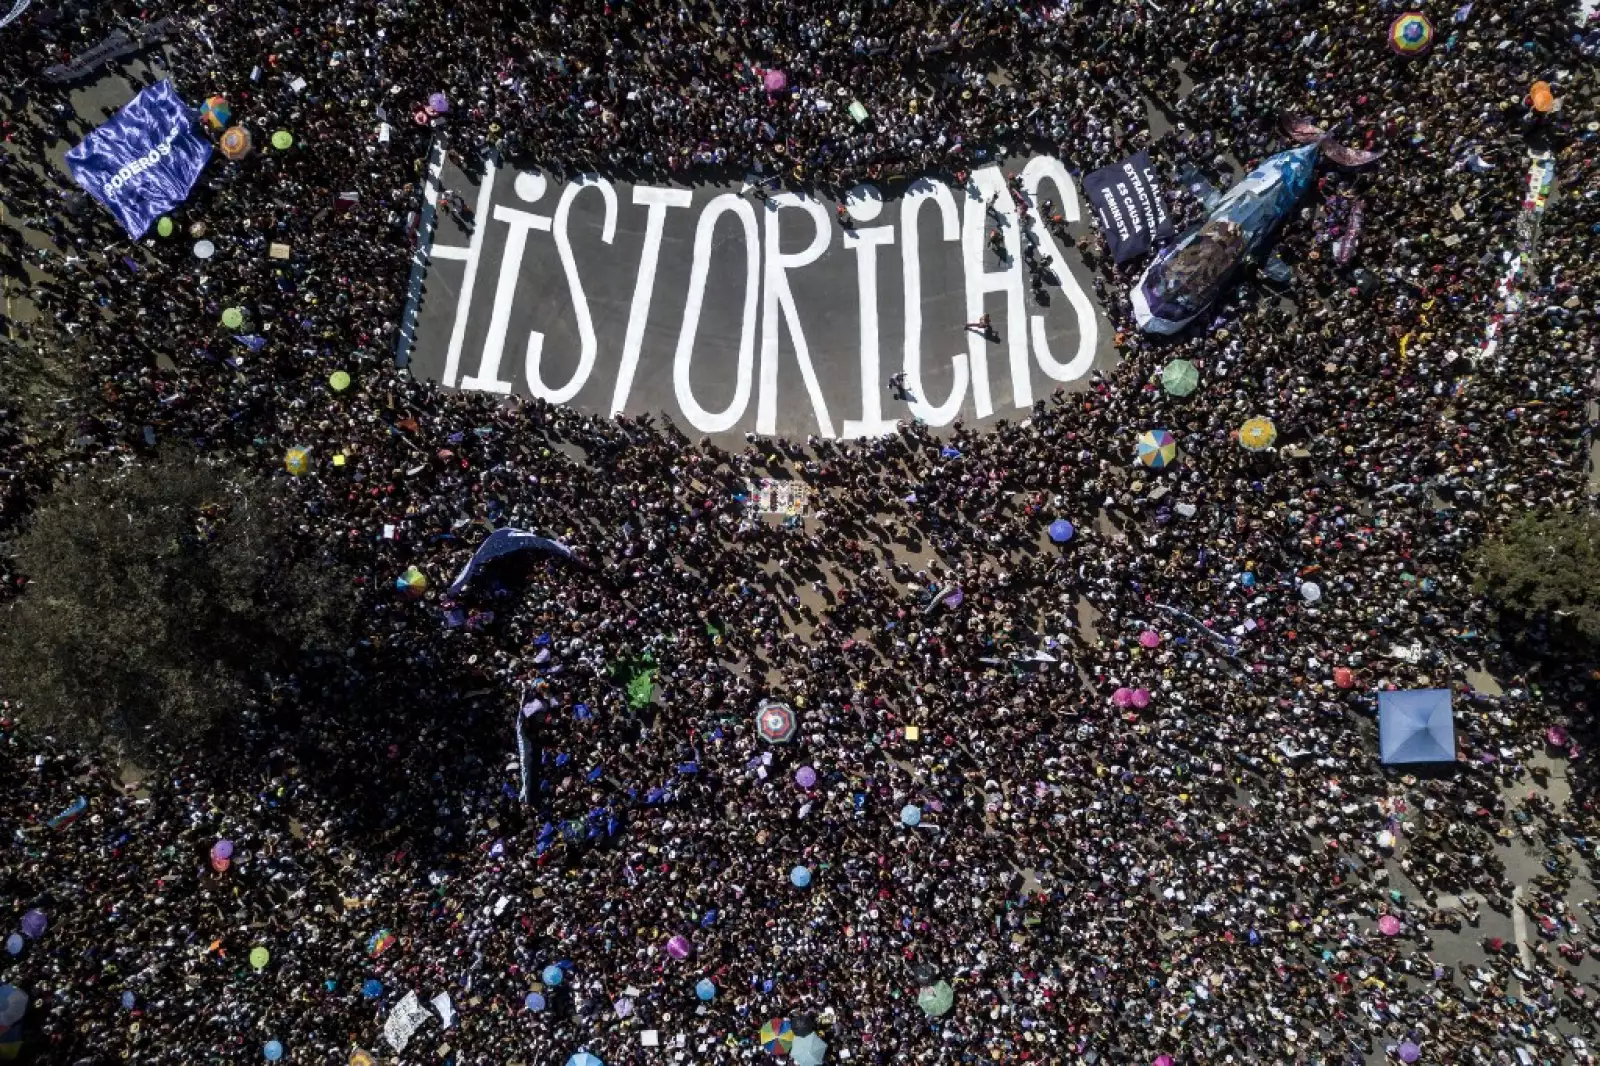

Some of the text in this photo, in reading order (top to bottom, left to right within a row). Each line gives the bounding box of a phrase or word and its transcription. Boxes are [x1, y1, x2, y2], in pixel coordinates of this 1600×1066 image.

[1143, 168, 1152, 183] LA
[1101, 187, 1130, 242] FEMINISTA
[1116, 182, 1143, 234] ES CAUSA
